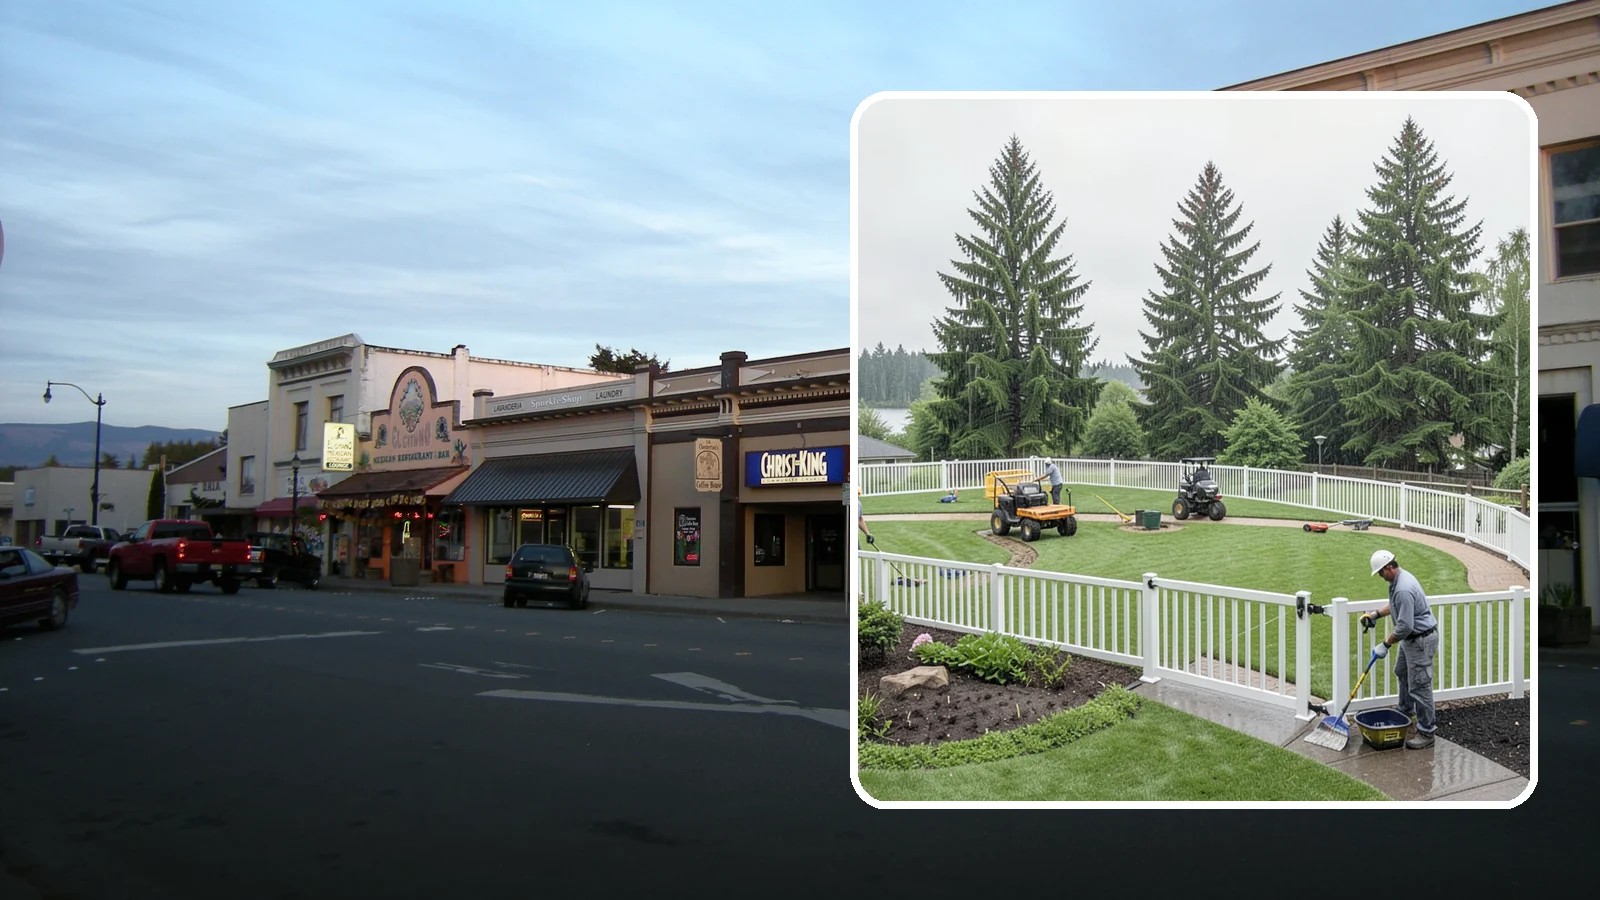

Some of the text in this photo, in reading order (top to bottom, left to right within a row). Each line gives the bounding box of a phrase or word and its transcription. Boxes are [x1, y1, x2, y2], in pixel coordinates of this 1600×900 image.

[595, 389, 623, 400] LAUNDRY
[493, 402, 522, 412] LAVANDERIA
[373, 450, 450, 464] MEXICAN RESTAURANT BAR
[760, 450, 827, 478] CHRIST KING
